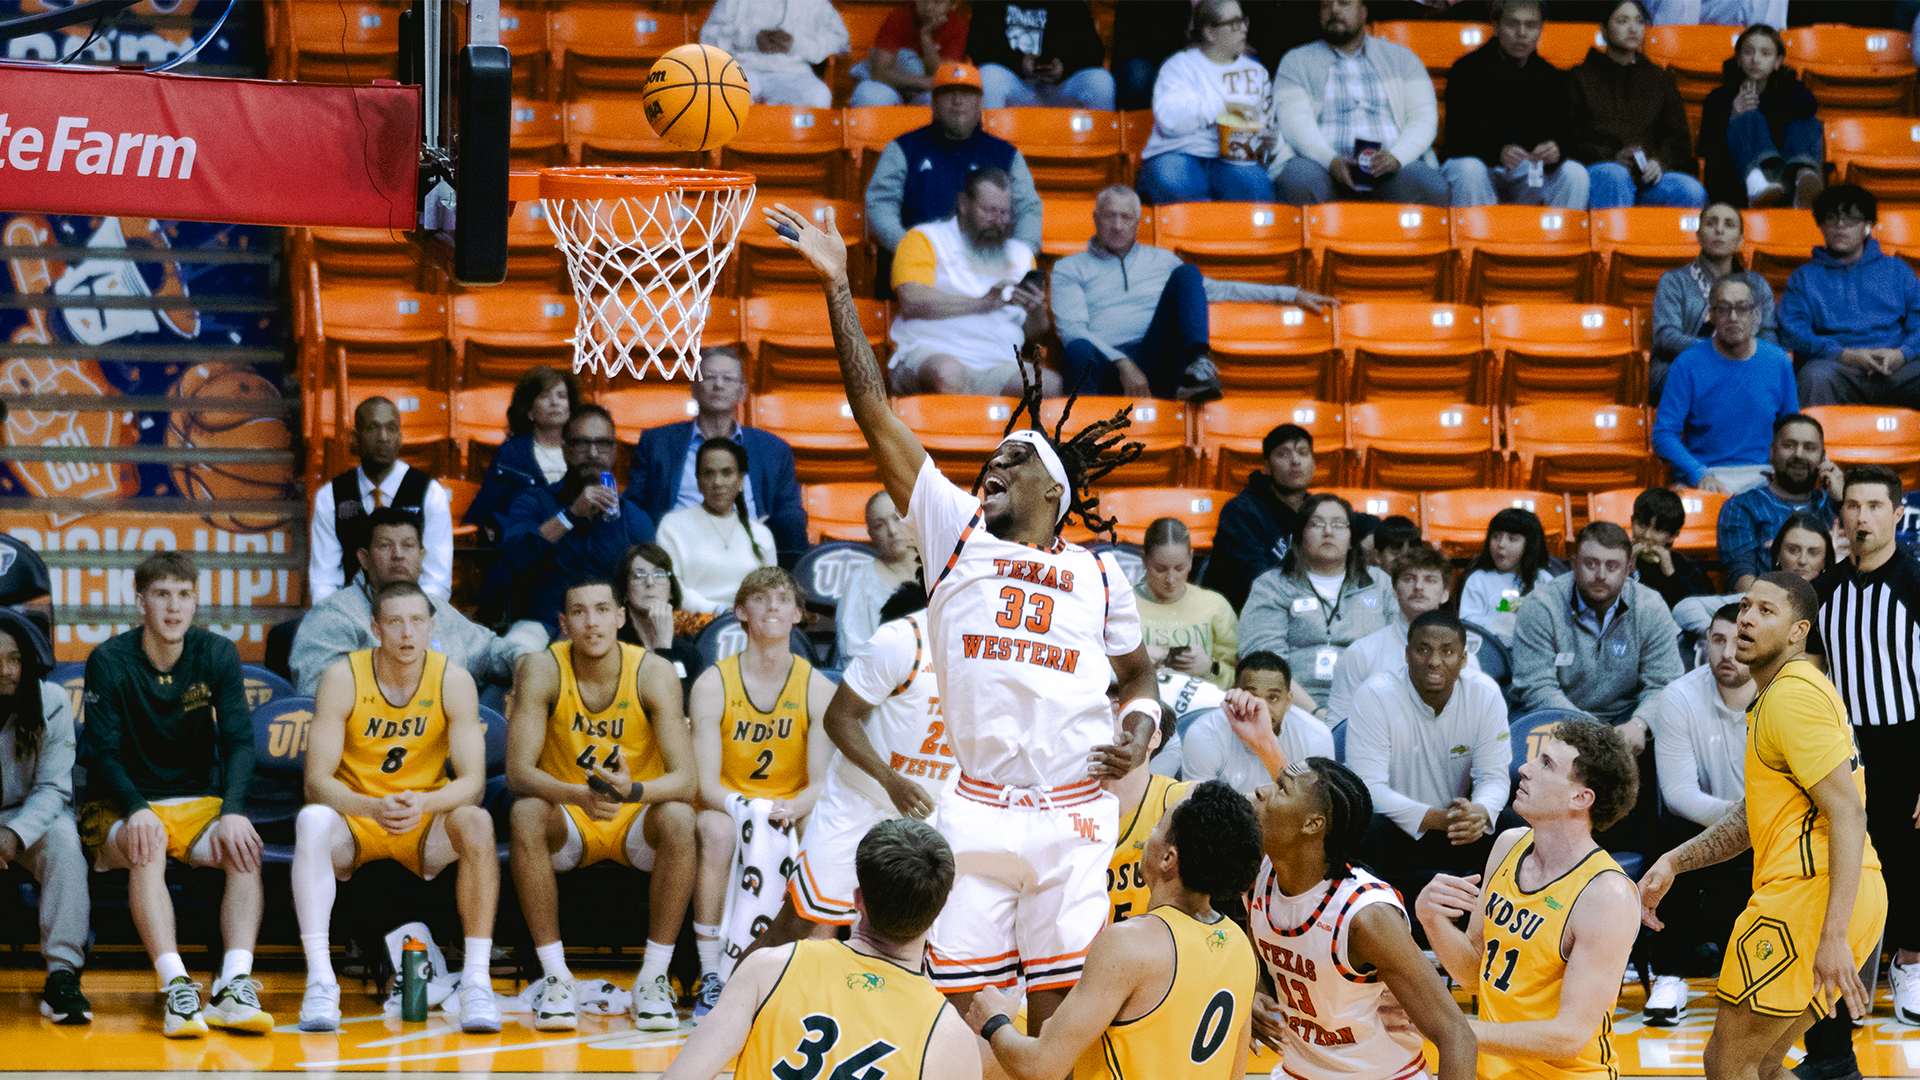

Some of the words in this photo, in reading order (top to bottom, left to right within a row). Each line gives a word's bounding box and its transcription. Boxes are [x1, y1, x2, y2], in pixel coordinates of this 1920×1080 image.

[47, 116, 197, 180] Farm
[993, 558, 1075, 593] TEXAS
[995, 585, 1055, 635] 33
[962, 634, 1080, 674] WESTERN
[1142, 622, 1211, 656] ISON
[268, 709, 315, 759] UT
[363, 716, 428, 739] NDSU
[379, 746, 408, 774] 8
[575, 744, 621, 774] 44
[748, 749, 774, 780] 2
[889, 751, 957, 781] WESTE
[1106, 861, 1148, 893] DSU
[1258, 938, 1317, 982] TEXAS
[1480, 938, 1521, 994] 11
[1276, 972, 1318, 1018] 13
[1190, 988, 1235, 1066] 0
[1282, 1010, 1356, 1047] STERN
[771, 1013, 901, 1080] 34
